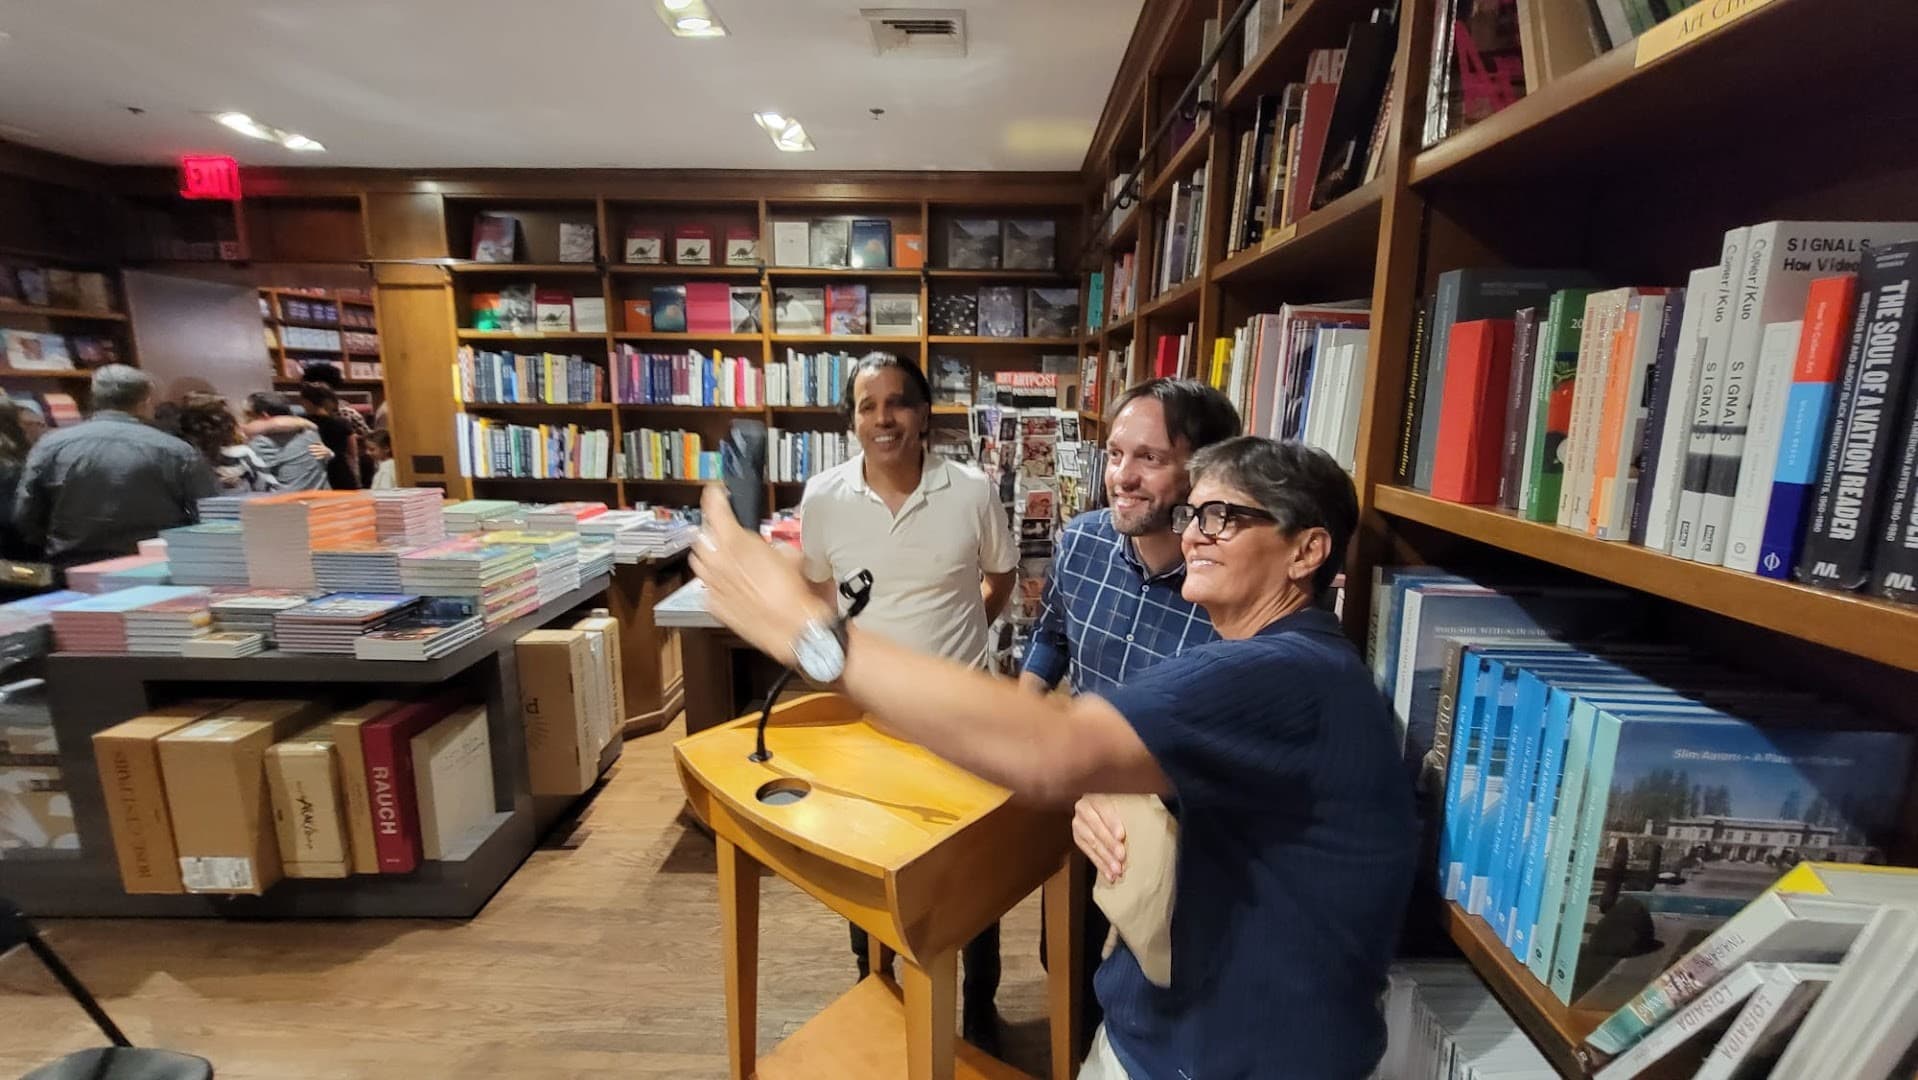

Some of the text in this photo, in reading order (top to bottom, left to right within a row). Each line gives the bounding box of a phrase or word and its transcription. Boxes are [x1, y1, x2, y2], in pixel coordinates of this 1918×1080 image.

[1783, 258, 1811, 271] How
[1787, 238, 1871, 252] SIGNALS
[1875, 279, 1910, 320] THE
[1866, 321, 1901, 369] SOUL
[1695, 362, 1717, 440] SIGNALS
[1720, 361, 1745, 441] SIGNALS
[1856, 395, 1884, 407] A
[1861, 370, 1890, 394] OF
[1830, 419, 1844, 460] AMERICAN
[1843, 408, 1881, 473] NATION
[1828, 475, 1867, 540] READER
[1433, 694, 1452, 770] OBAMA
[1673, 749, 1700, 759] Slim
[372, 766, 397, 834] RAUCH
[1676, 984, 1733, 1031] LOISAIDA
[1721, 994, 1774, 1060] LOISAIDA
